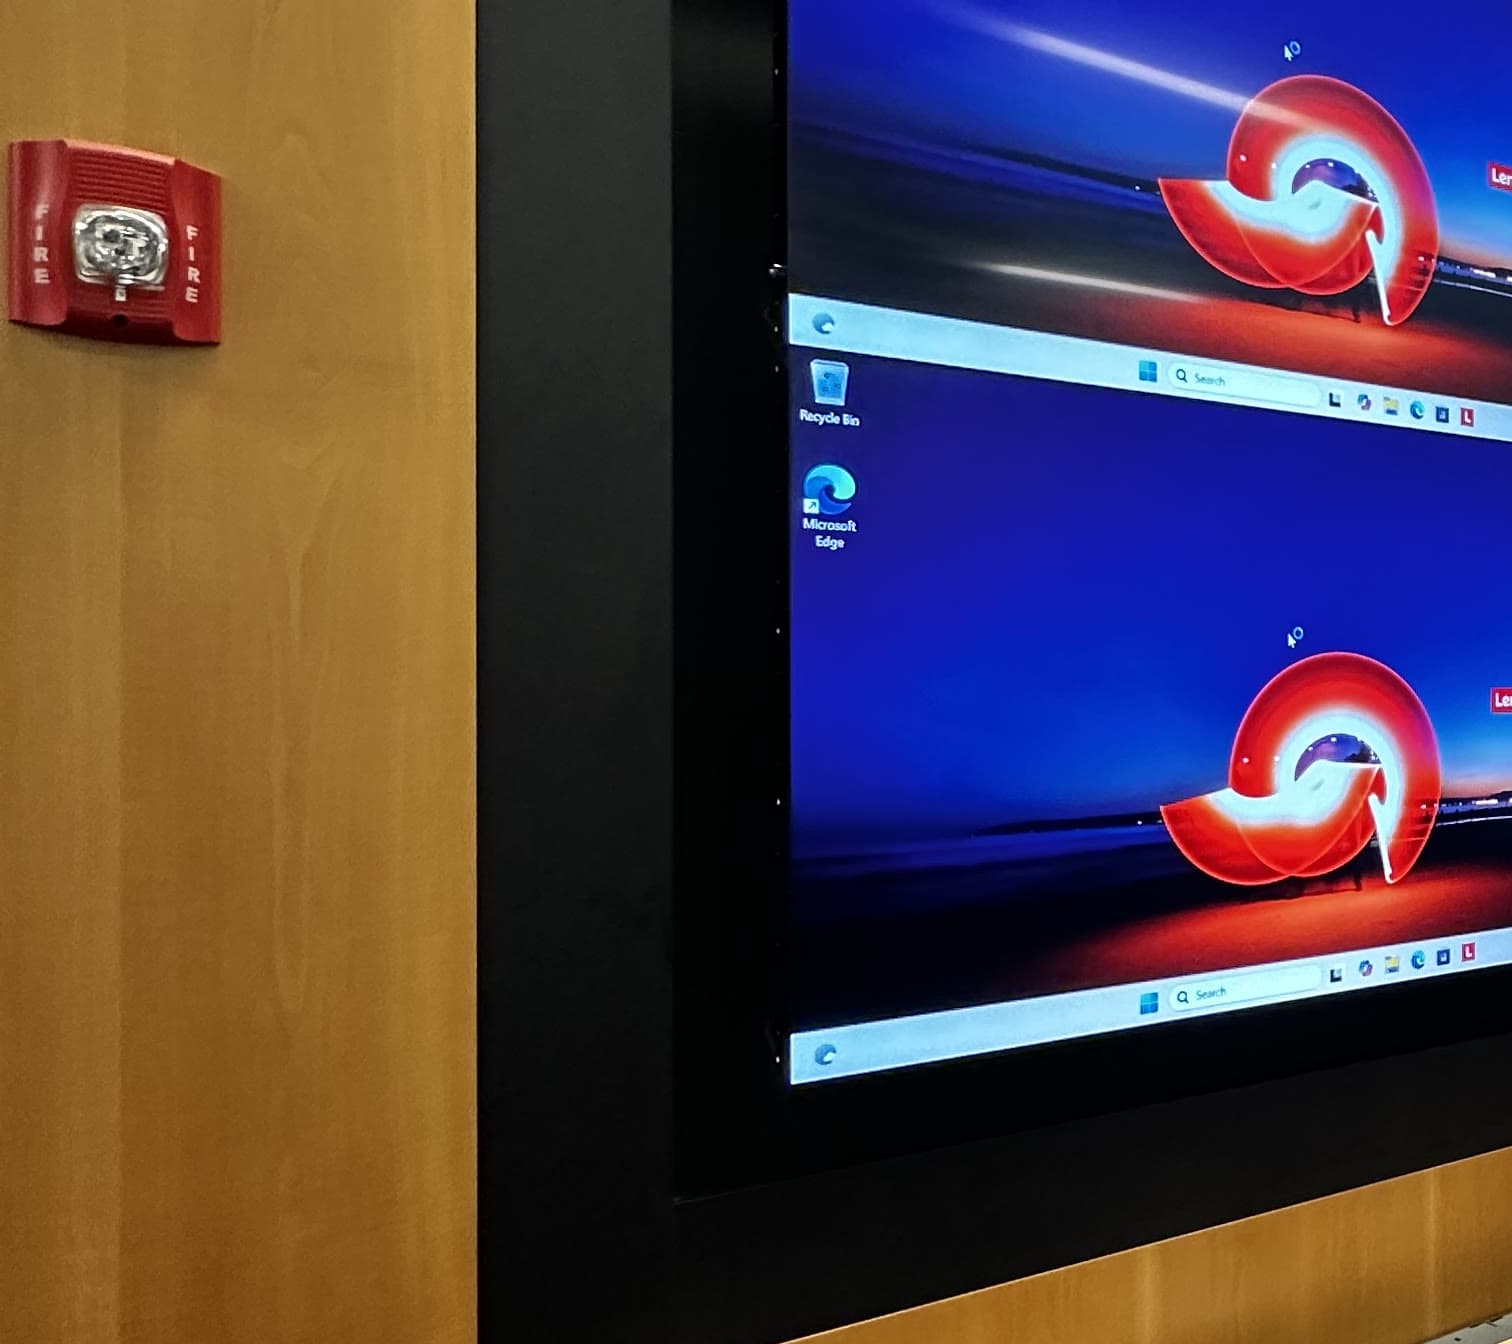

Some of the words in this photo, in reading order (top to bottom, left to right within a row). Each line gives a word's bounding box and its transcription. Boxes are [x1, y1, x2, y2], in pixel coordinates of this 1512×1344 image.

[34, 204, 50, 284] FIRE
[186, 225, 201, 303] FIRE
[1194, 372, 1226, 387] Search
[800, 409, 840, 425] Recycle
[843, 413, 860, 426] Bin
[803, 517, 857, 533] Microsoft
[815, 535, 845, 551] Edge
[1195, 986, 1227, 1001] Search
